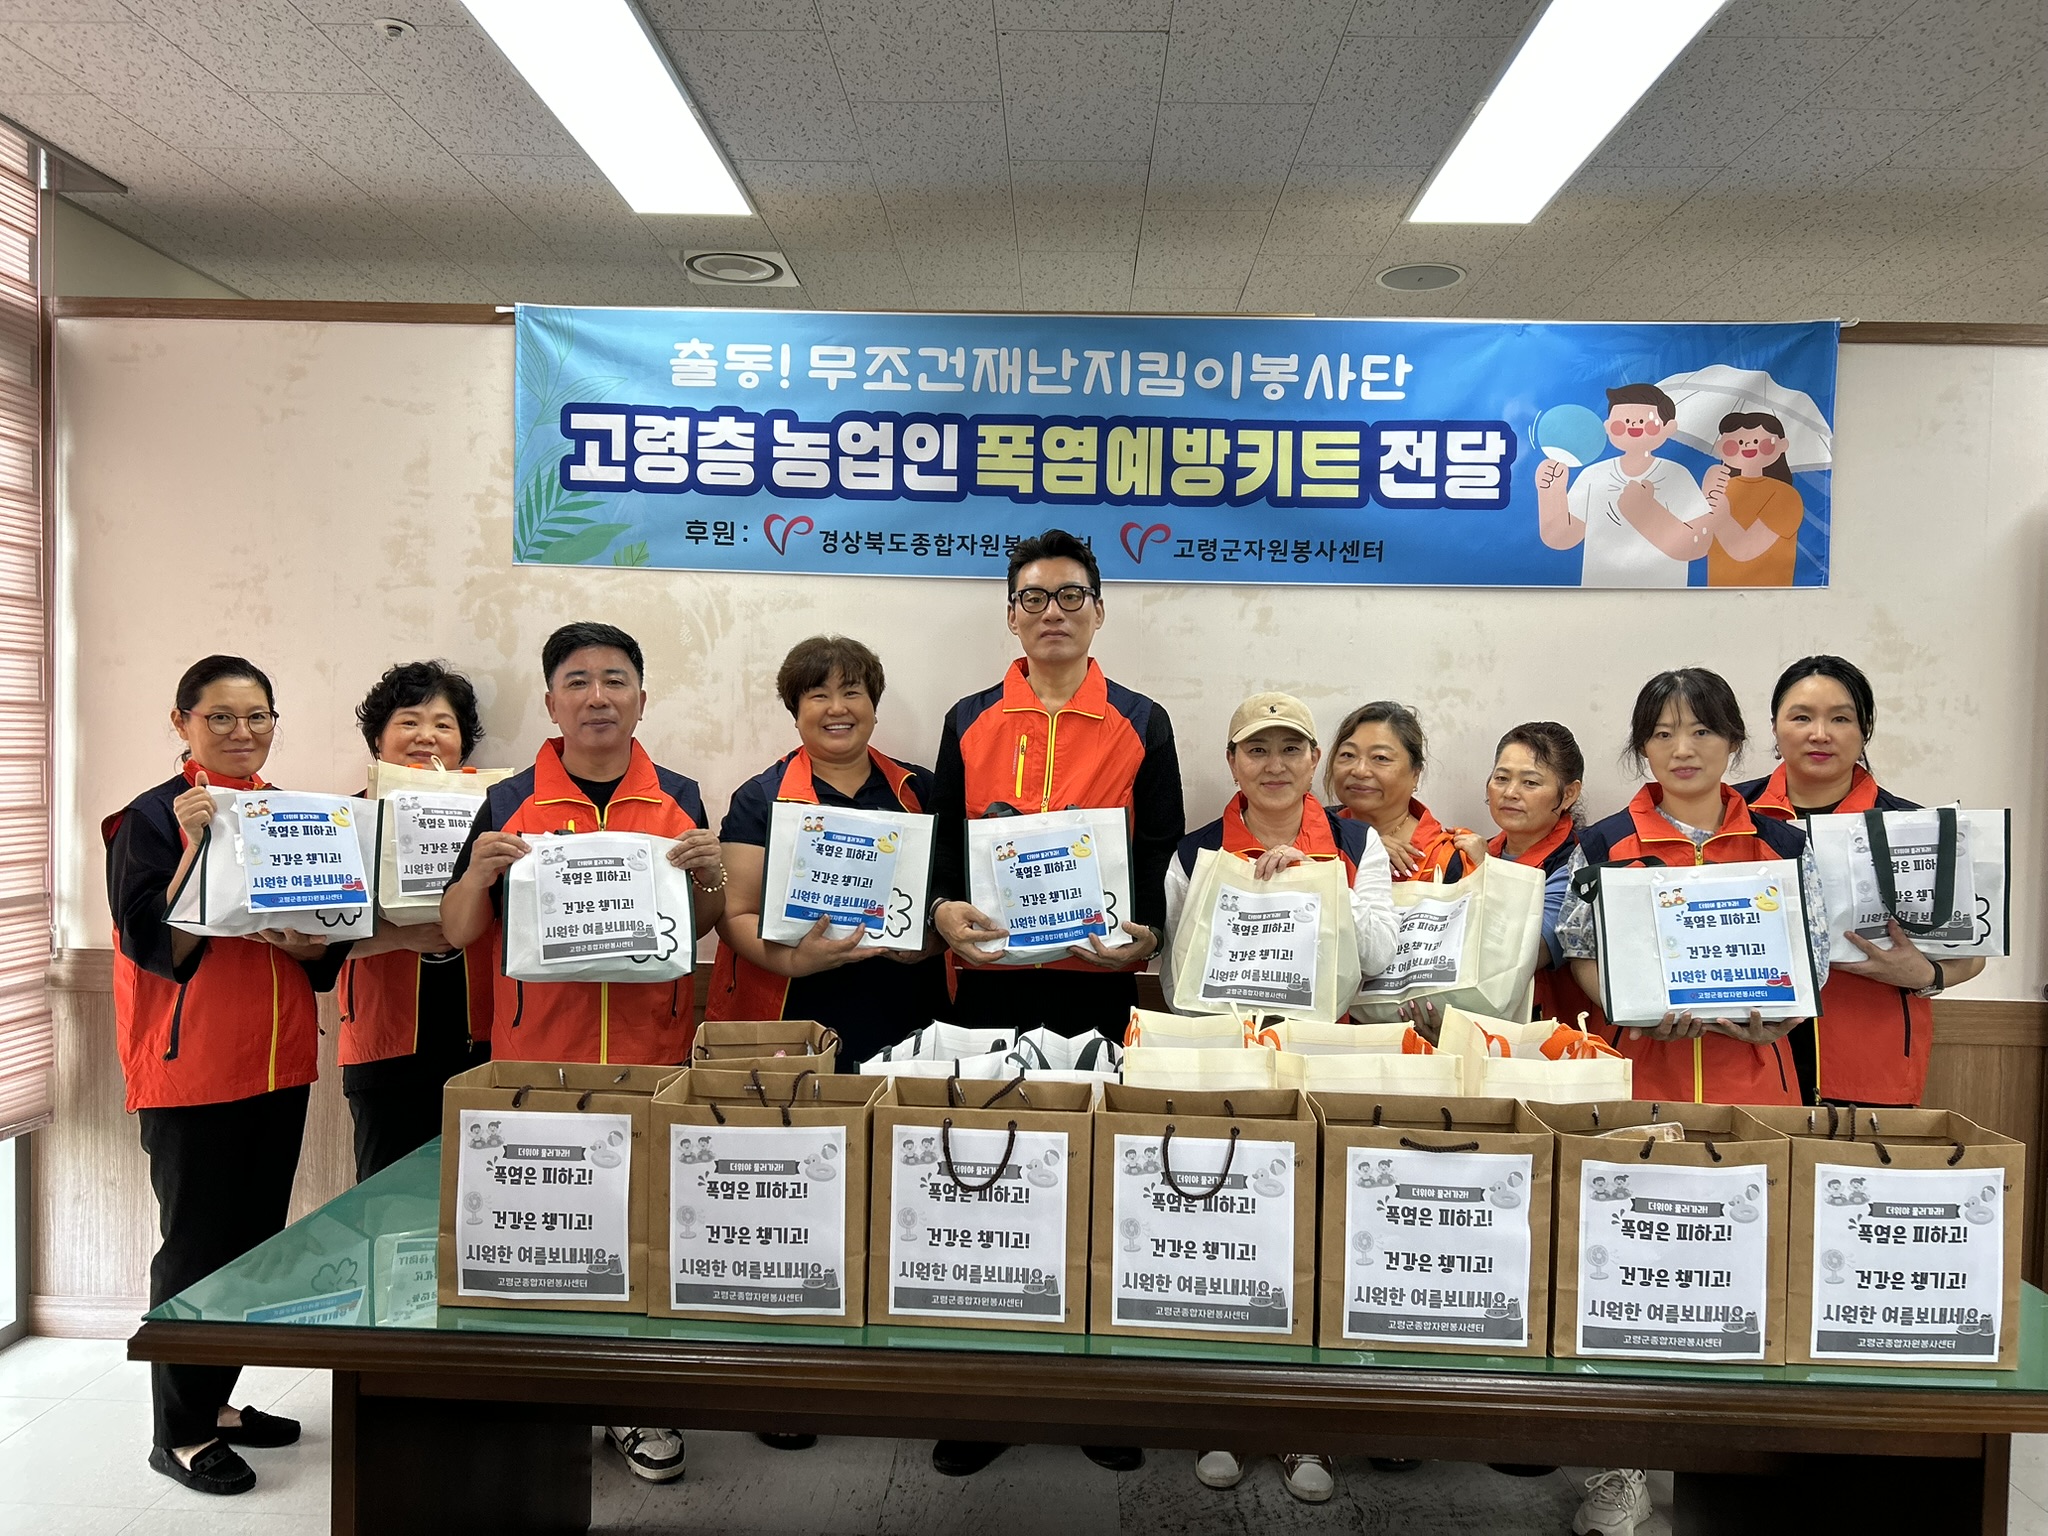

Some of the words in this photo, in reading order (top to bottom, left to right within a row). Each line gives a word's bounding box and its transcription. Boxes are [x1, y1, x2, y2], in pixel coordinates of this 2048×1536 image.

[669, 337, 792, 390] 출동!
[808, 343, 1414, 402] 무조건재난지킴이봉사단
[567, 412, 755, 487] 고령층
[770, 418, 960, 493] 농업인
[974, 421, 1361, 499] 폭염예방키트
[1378, 429, 1508, 501] 전달
[1173, 537, 1385, 564] 고령군자원봉사센터
[418, 817, 445, 829] 폭염은
[267, 825, 300, 838] 폭염은
[302, 825, 337, 836] 피하고!
[419, 842, 448, 854] 건강은
[815, 844, 843, 858] 폭염은
[846, 848, 877, 861] 피하고!
[270, 853, 303, 866] 건강은
[305, 853, 342, 865] 챙기고!
[404, 862, 433, 874] 시원한
[1015, 866, 1042, 879] 폭염은
[1044, 859, 1077, 875] 피하고!
[252, 875, 288, 888] 시원한
[562, 872, 593, 885] 폭염은
[596, 871, 631, 883] 피하고!
[811, 870, 839, 886] 건강은
[841, 875, 873, 888] 챙기고!
[791, 889, 821, 904] 시원한
[1020, 892, 1047, 907] 건강은
[1049, 888, 1082, 902] 챙기고!
[563, 901, 595, 915] 건강은
[598, 899, 634, 912] 챙기고!
[1010, 916, 1037, 929] 시원한
[1683, 916, 1717, 929] 폭염은
[1721, 913, 1760, 926] 피하고!
[546, 924, 579, 939] 시원한
[1231, 923, 1259, 936] 폭염은
[1262, 923, 1294, 934] 피하고!
[1229, 950, 1256, 962] 건강은
[1259, 949, 1293, 960] 챙기고!
[1687, 945, 1722, 959] 건강은
[1725, 944, 1766, 957] 챙기고!
[1209, 969, 1238, 982] 시원한
[1671, 970, 1707, 983] 시원한
[518, 1147, 539, 1157] 더위야
[730, 1163, 752, 1171] 더위야
[494, 1166, 537, 1185] 폭염은
[543, 1167, 593, 1185] 피하고!
[706, 1181, 750, 1200] 폭염은
[756, 1182, 808, 1199] 피하고!
[929, 1182, 973, 1203] 폭염은
[978, 1186, 1030, 1204] 피하고!
[1412, 1187, 1435, 1197] 더위야
[1152, 1193, 1197, 1213] 폭염은
[1203, 1196, 1256, 1214] 피하고!
[1648, 1202, 1673, 1211] 더위야
[1885, 1206, 1910, 1215] 더위야
[492, 1211, 537, 1230] 건강은
[542, 1213, 593, 1231] 챙기고!
[1386, 1206, 1433, 1227] 폭염은
[1439, 1209, 1493, 1227] 피하고!
[706, 1225, 750, 1245] 건강은
[756, 1227, 809, 1245] 챙기고!
[927, 1228, 972, 1248] 건강은
[978, 1230, 1030, 1249] 챙기고!
[1621, 1219, 1670, 1241] 폭염은
[1676, 1223, 1732, 1242] 피하고!
[1858, 1224, 1907, 1244] 폭염은
[1913, 1226, 1968, 1243] 피하고!
[466, 1245, 513, 1264] 시원한
[1150, 1238, 1197, 1260] 건강은
[1203, 1241, 1257, 1261] 챙기고!
[680, 1258, 727, 1278] 시원한
[1384, 1251, 1433, 1272] 건강은
[1438, 1254, 1493, 1273] 챙기고!
[899, 1261, 947, 1281] 시원한
[1619, 1266, 1670, 1288] 건강은
[1675, 1269, 1731, 1289] 챙기고!
[498, 1277, 588, 1288] 고령군종합자원봉사센터
[1122, 1272, 1172, 1293] 시원한
[1856, 1270, 1905, 1290] 건강은
[1911, 1271, 1967, 1291] 챙기고!
[713, 1291, 803, 1302] 고령군종합자원봉사센터
[932, 1295, 1023, 1308] 고령군종합자원봉사센터
[1354, 1286, 1406, 1307] 시원한
[1156, 1306, 1249, 1320] 고령군종합자원봉사센터
[1588, 1300, 1642, 1322] 시원한
[1823, 1304, 1877, 1325] 시원한
[1388, 1320, 1485, 1333] 고령군종합자원봉사센터
[1623, 1335, 1722, 1348] 고령군종합자원봉사센터
[1857, 1338, 1956, 1349] 고령군종합자원봉사센터
